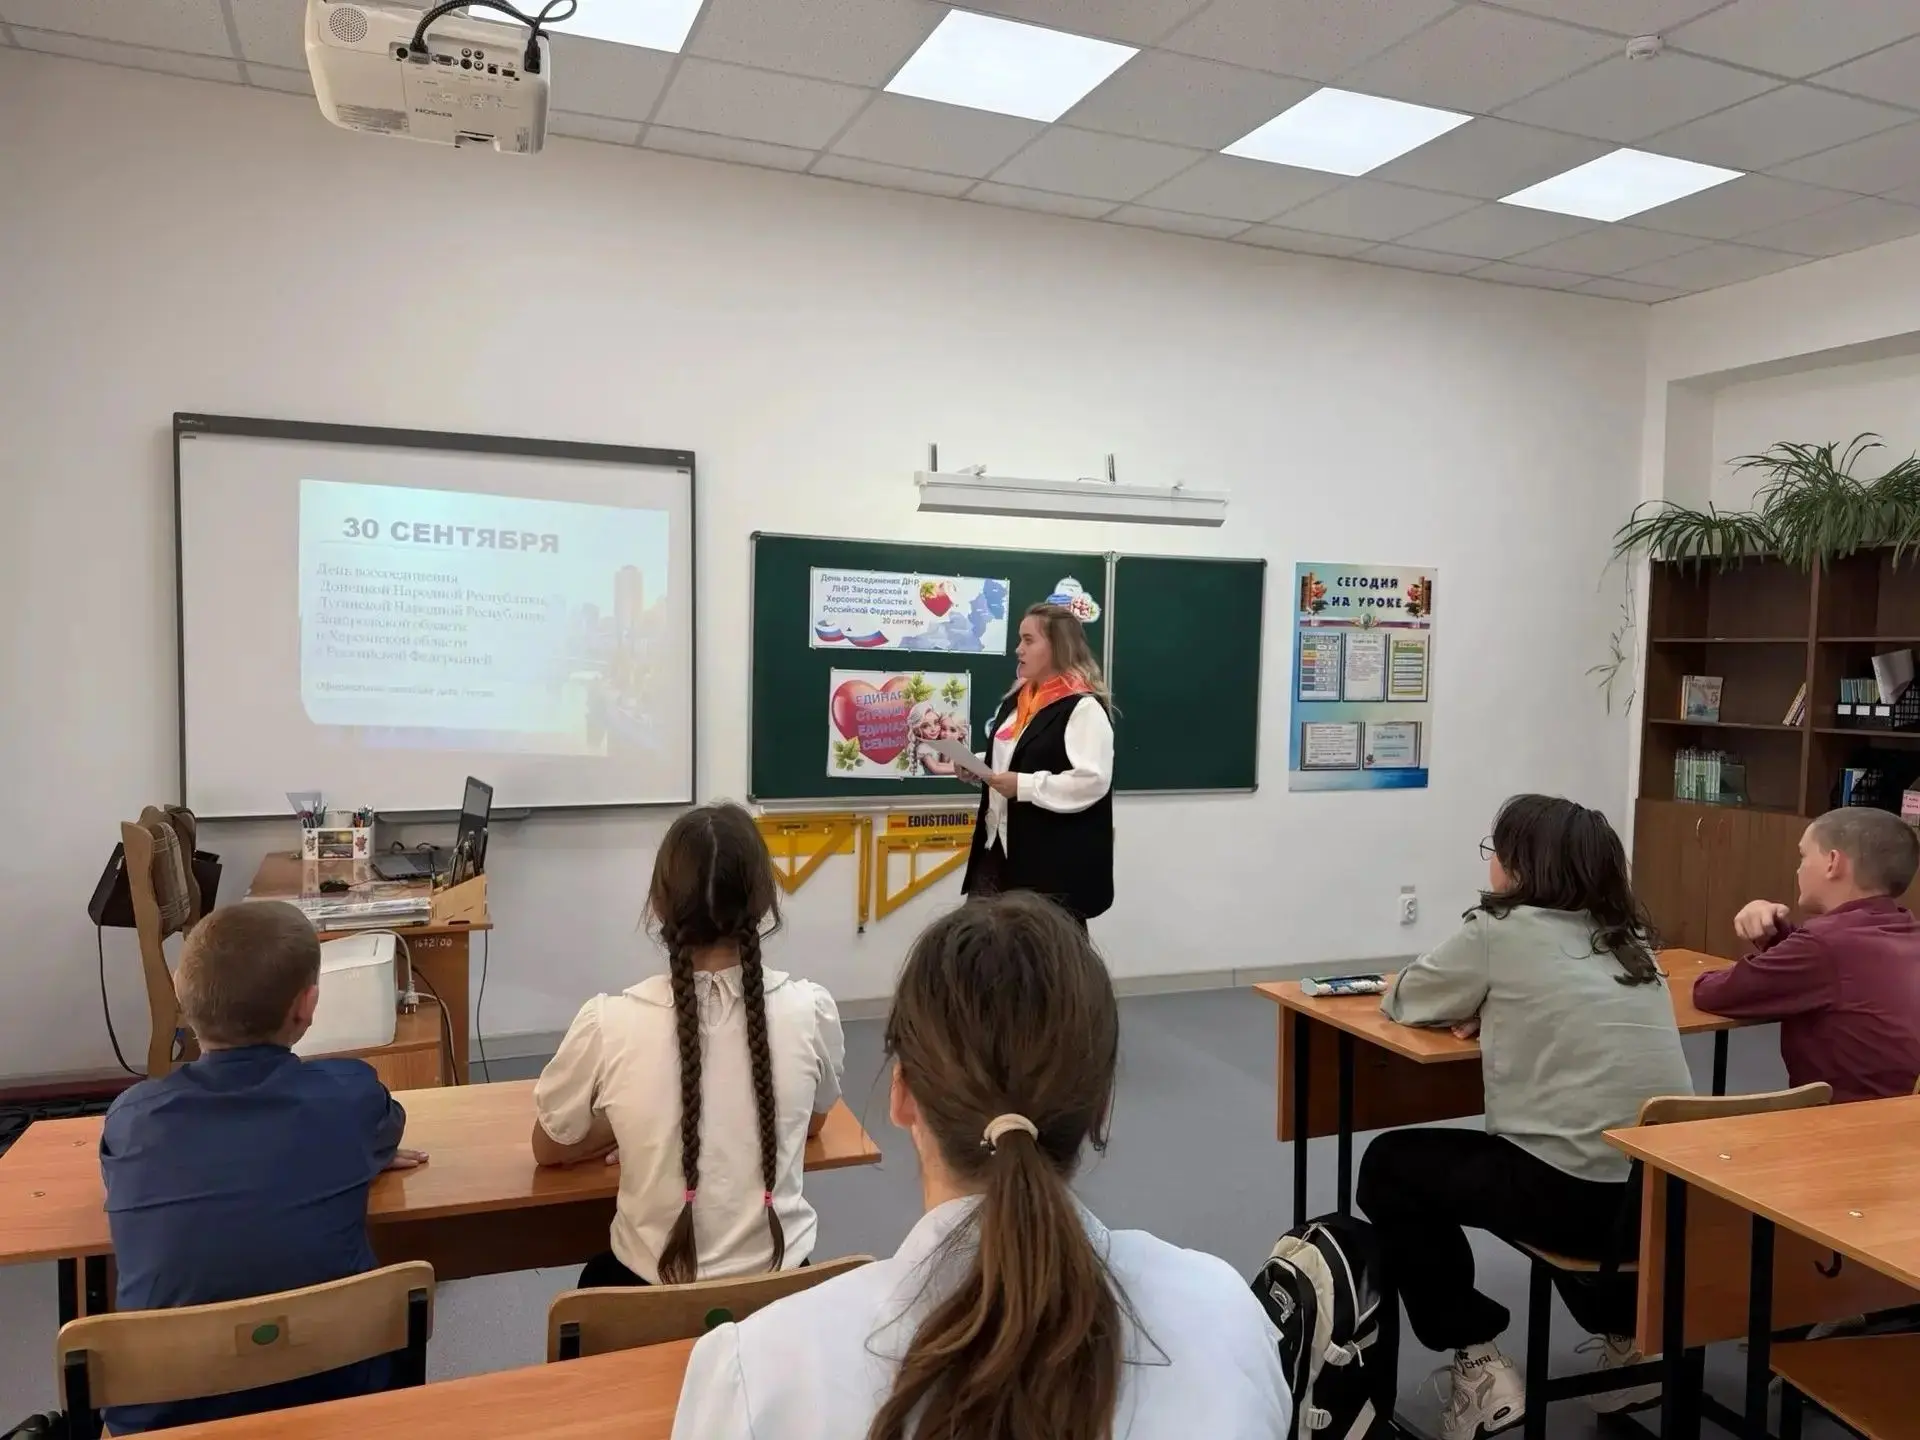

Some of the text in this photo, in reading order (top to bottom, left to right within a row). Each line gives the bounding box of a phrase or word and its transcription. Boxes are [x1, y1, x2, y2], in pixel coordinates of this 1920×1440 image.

[343, 517, 559, 553] 30 СЕНТЯБРЯ
[821, 573, 841, 582] День
[1336, 576, 1399, 590] СЕГОДНЯ
[1331, 596, 1403, 609] НА УРОКЕ
[908, 812, 969, 828] EDUSTRONG
